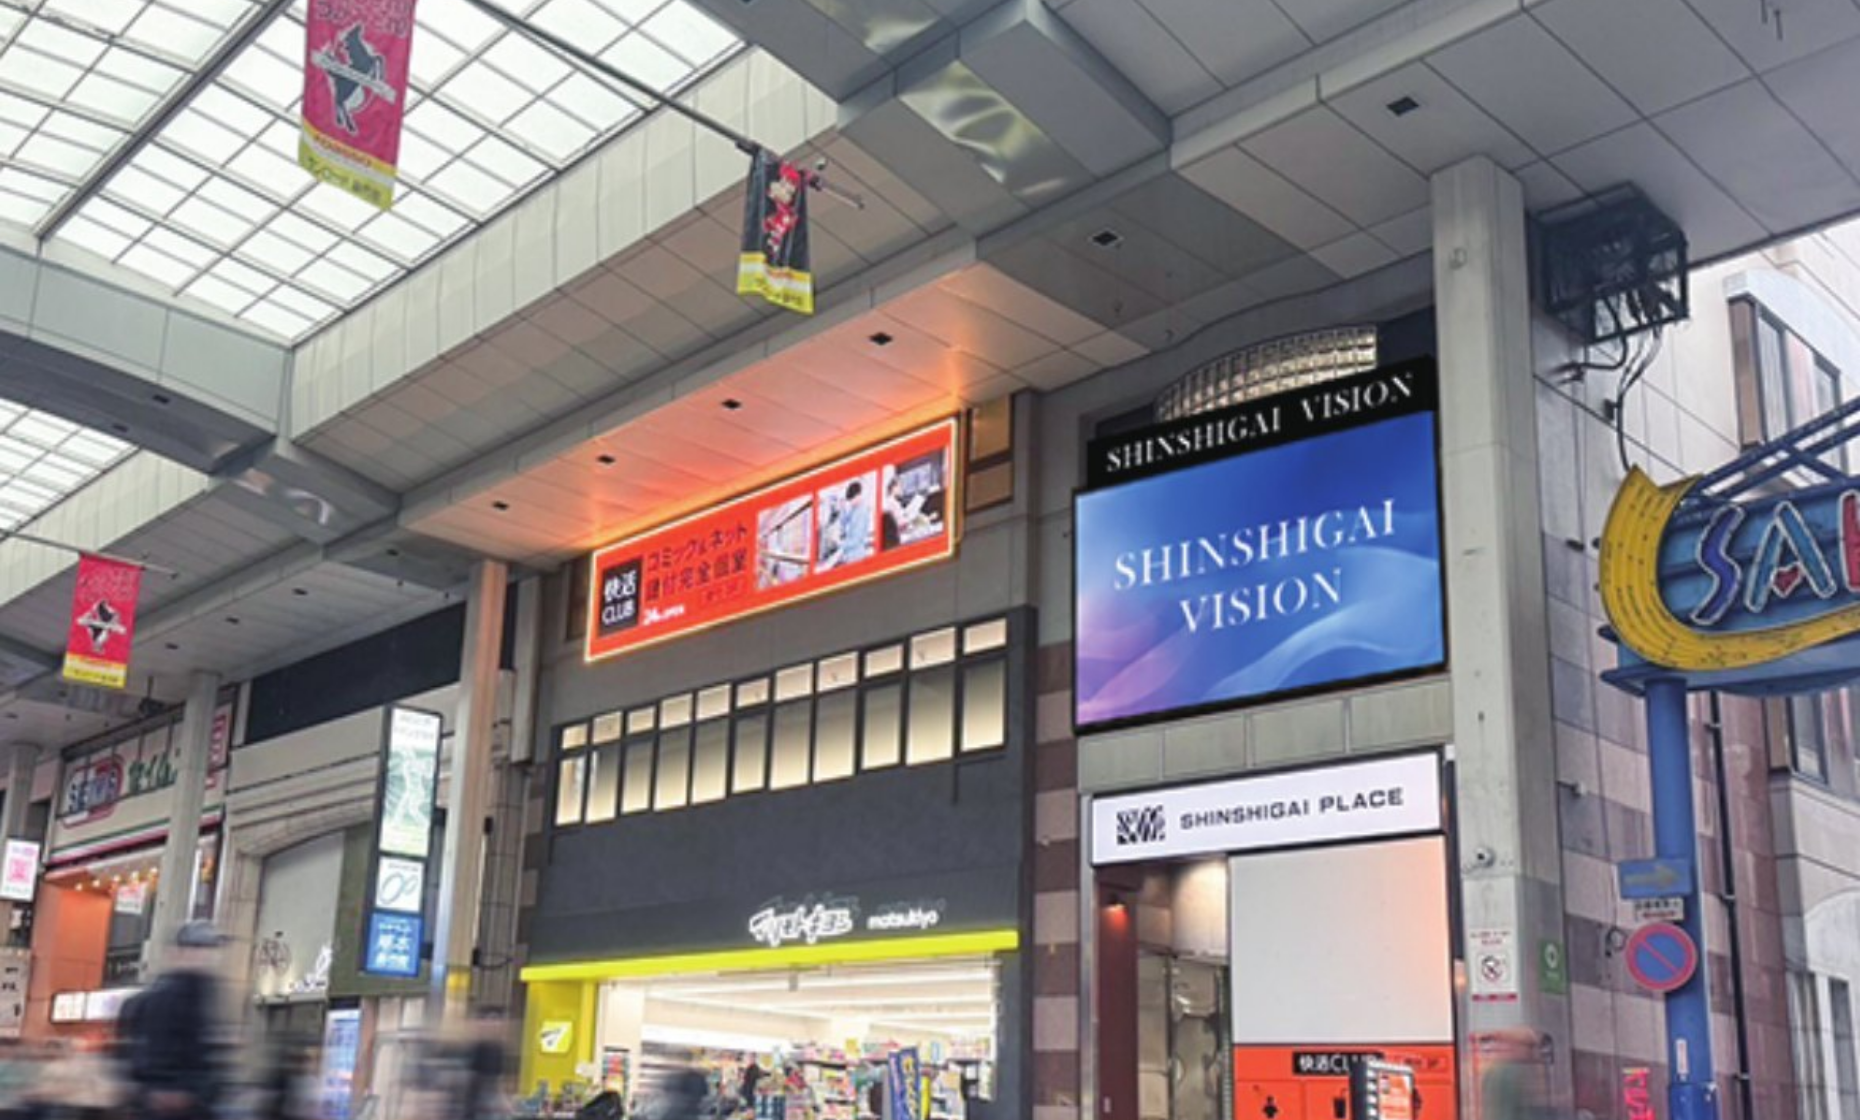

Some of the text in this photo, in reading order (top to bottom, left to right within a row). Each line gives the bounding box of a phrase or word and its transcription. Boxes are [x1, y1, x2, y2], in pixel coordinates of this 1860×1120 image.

[1106, 371, 1414, 472] SHINSHIGAI VISION
[1113, 498, 1396, 591] SHINSHIGAI
[604, 568, 638, 602] 快活
[1179, 567, 1343, 633] VISION
[602, 598, 636, 625] CLUB
[1180, 786, 1404, 831] SHINSHIGAI PLACE
[867, 907, 940, 930] matsukiyo
